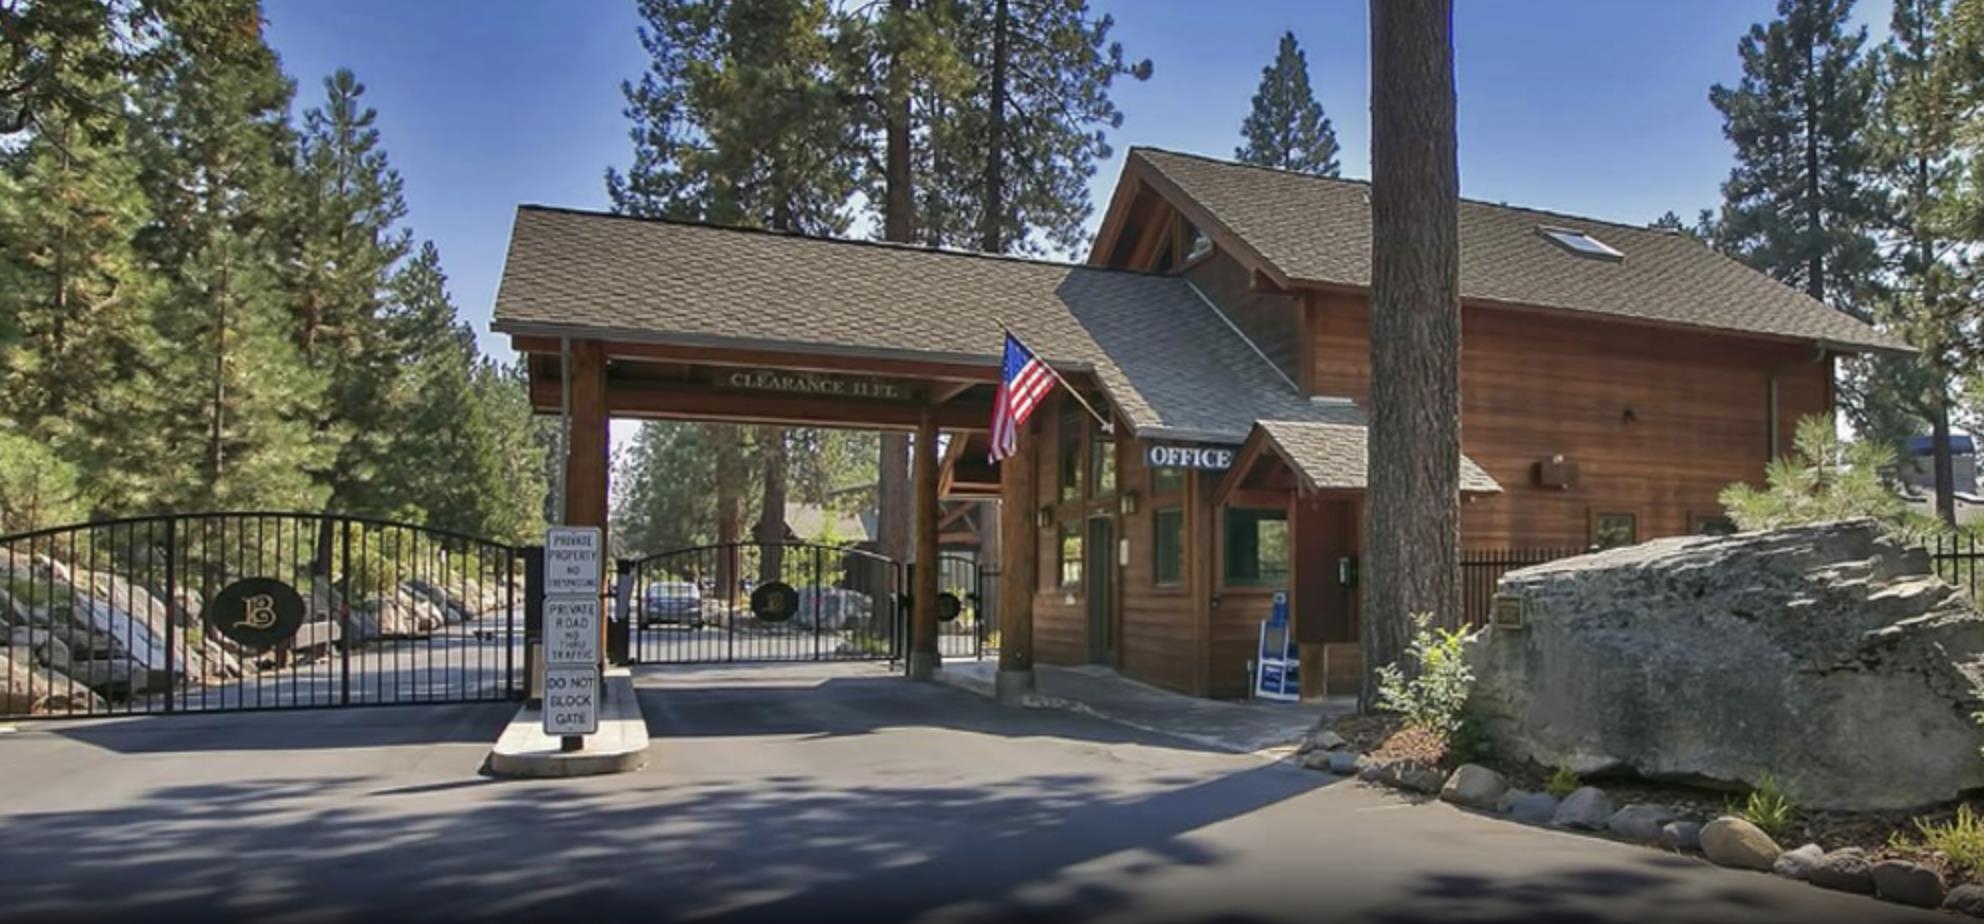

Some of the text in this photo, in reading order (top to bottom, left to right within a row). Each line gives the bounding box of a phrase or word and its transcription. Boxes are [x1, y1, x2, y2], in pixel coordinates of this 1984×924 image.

[730, 372, 845, 394] CLEARANCE
[1150, 445, 1231, 469] OFFICE
[553, 535, 592, 547] PRIVATE
[549, 550, 596, 561] PROPERTY
[566, 566, 580, 576] NO
[232, 593, 276, 629] B
[550, 604, 595, 616] PRIVATE
[556, 617, 589, 629] ROAD
[566, 630, 580, 640] NO
[552, 650, 593, 660] TRAFFIC
[549, 677, 593, 689] DO NOT
[551, 695, 592, 707] BLOCK
[555, 712, 586, 725] GATE
